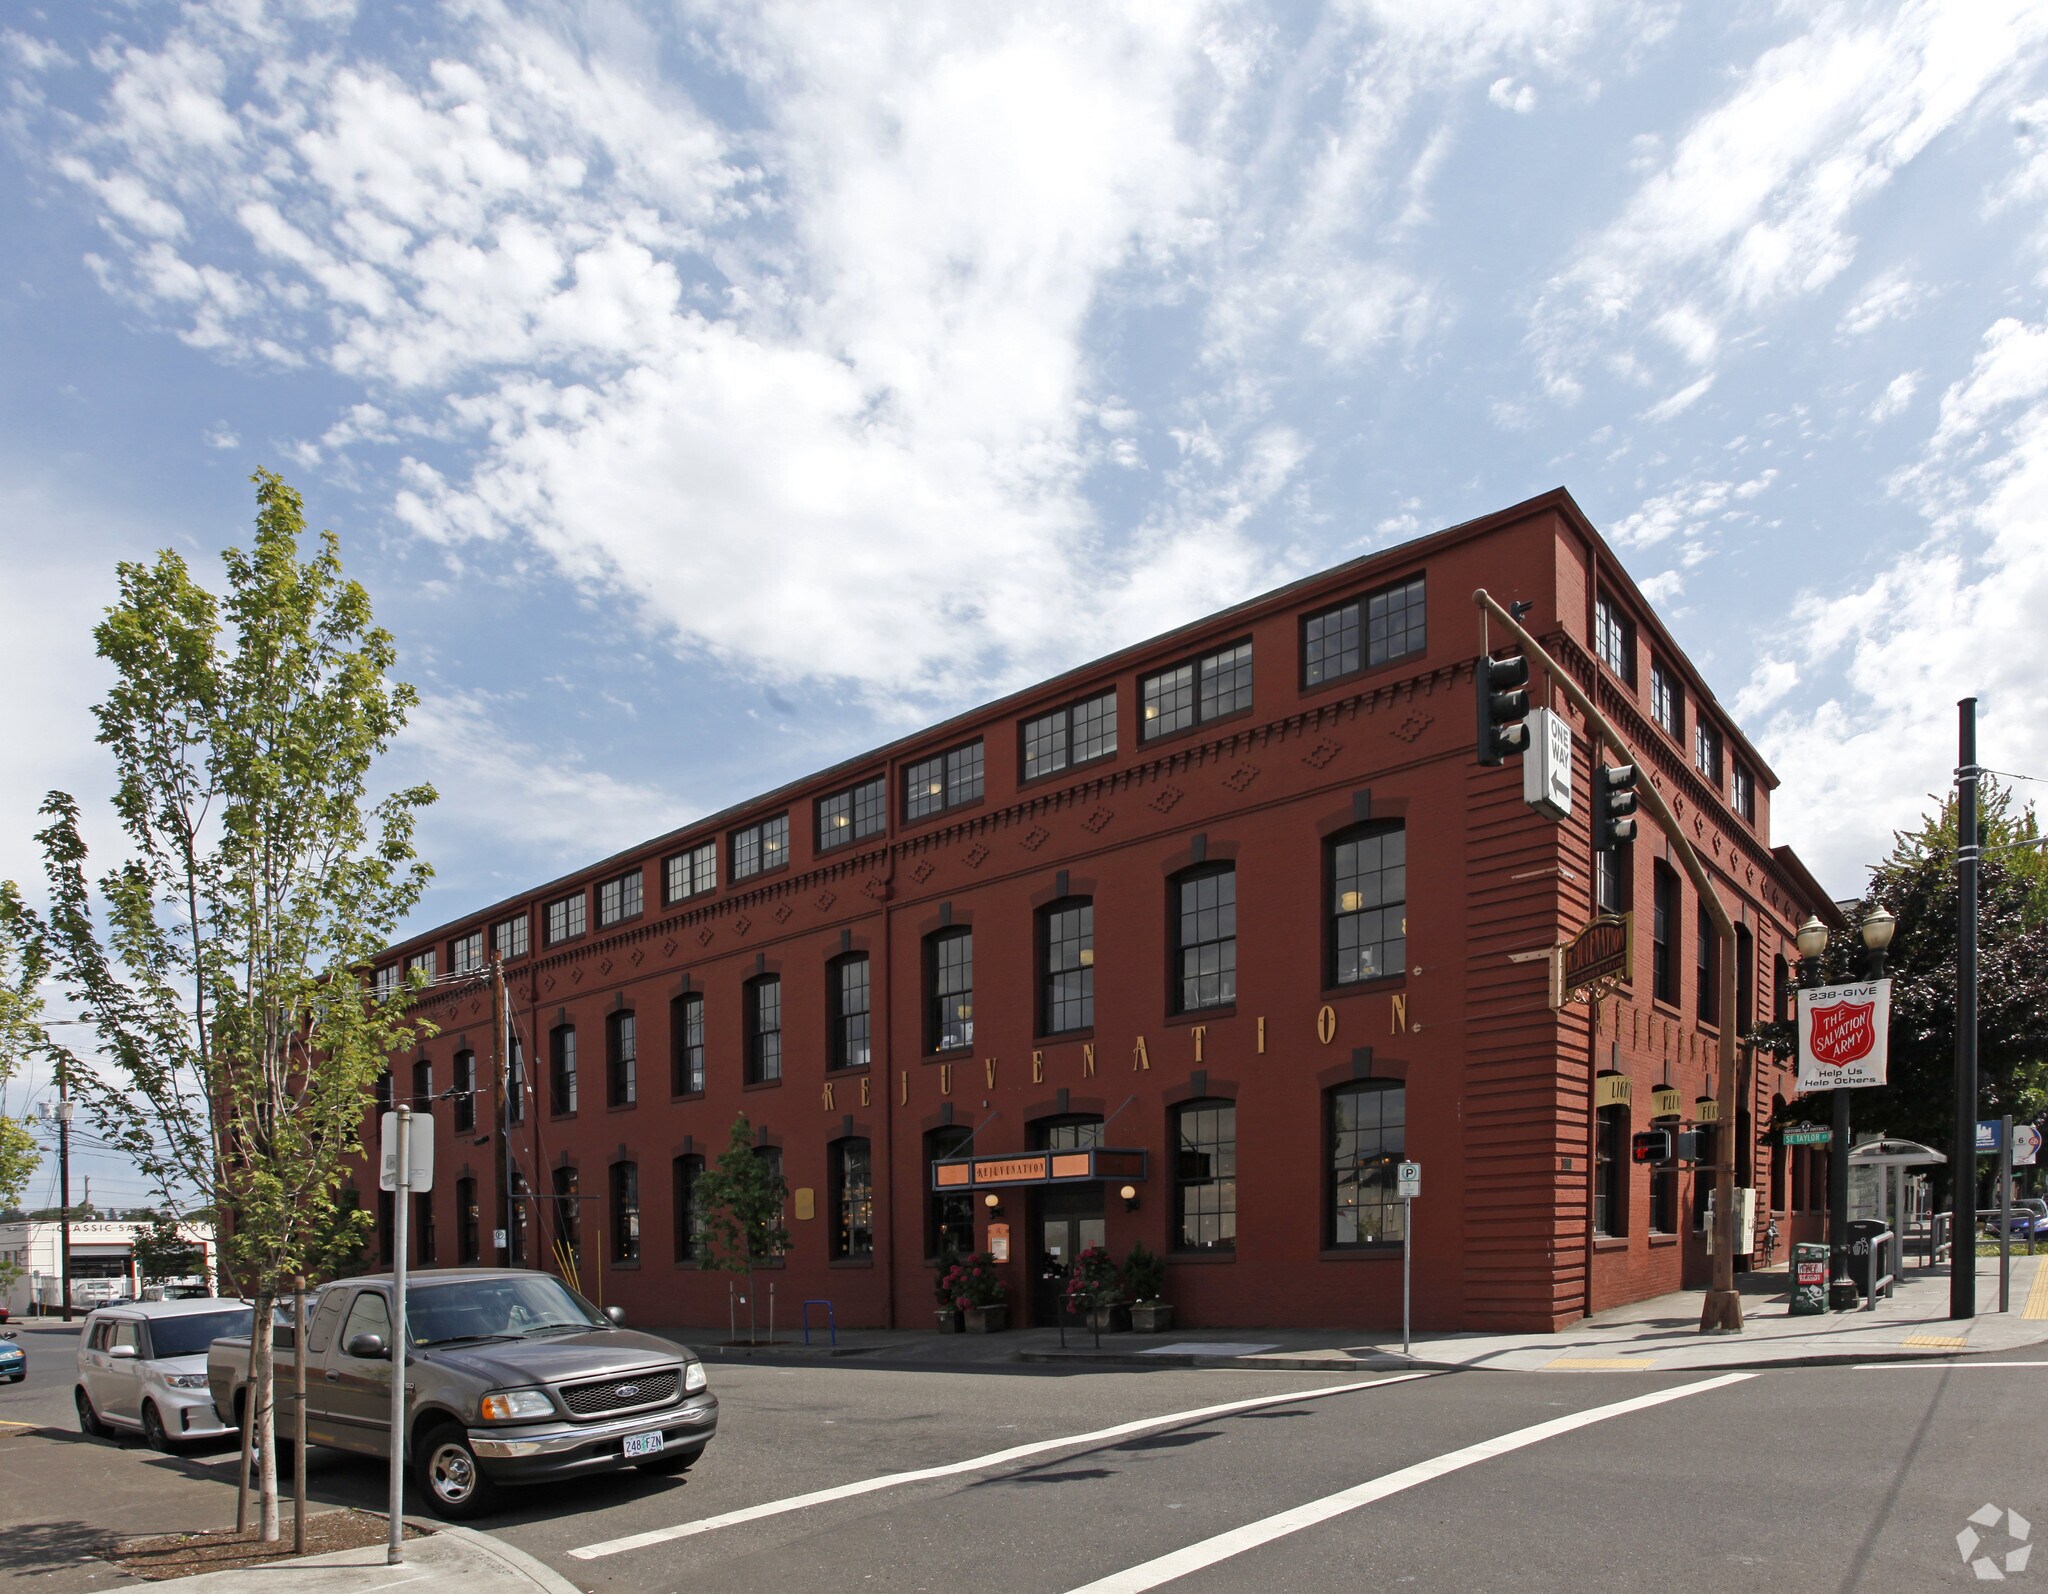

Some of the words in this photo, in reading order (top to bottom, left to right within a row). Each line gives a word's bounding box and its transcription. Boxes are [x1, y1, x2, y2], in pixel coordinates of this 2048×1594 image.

[1551, 719, 1569, 747] ONE
[1551, 740, 1569, 769] WAY
[1809, 987, 1877, 1001] 238-GIVE
[1823, 1008, 1846, 1030] THE
[1816, 1011, 1866, 1052] SALVATION
[1832, 1029, 1864, 1058] ARMY
[821, 993, 1407, 1112] REJUVENATION
[1819, 1069, 1842, 1078] Help
[1834, 1077, 1876, 1085] Others
[1785, 1135, 1794, 1143] SE
[1796, 1133, 1820, 1142] TAYLOR
[977, 1162, 1045, 1178] REJUVENATION
[1405, 1168, 1413, 1178] P
[57, 1224, 112, 1232] CASSIC
[118, 1224, 152, 1232] SAH
[626, 1439, 641, 1453] 248
[645, 1435, 662, 1449] FZN
